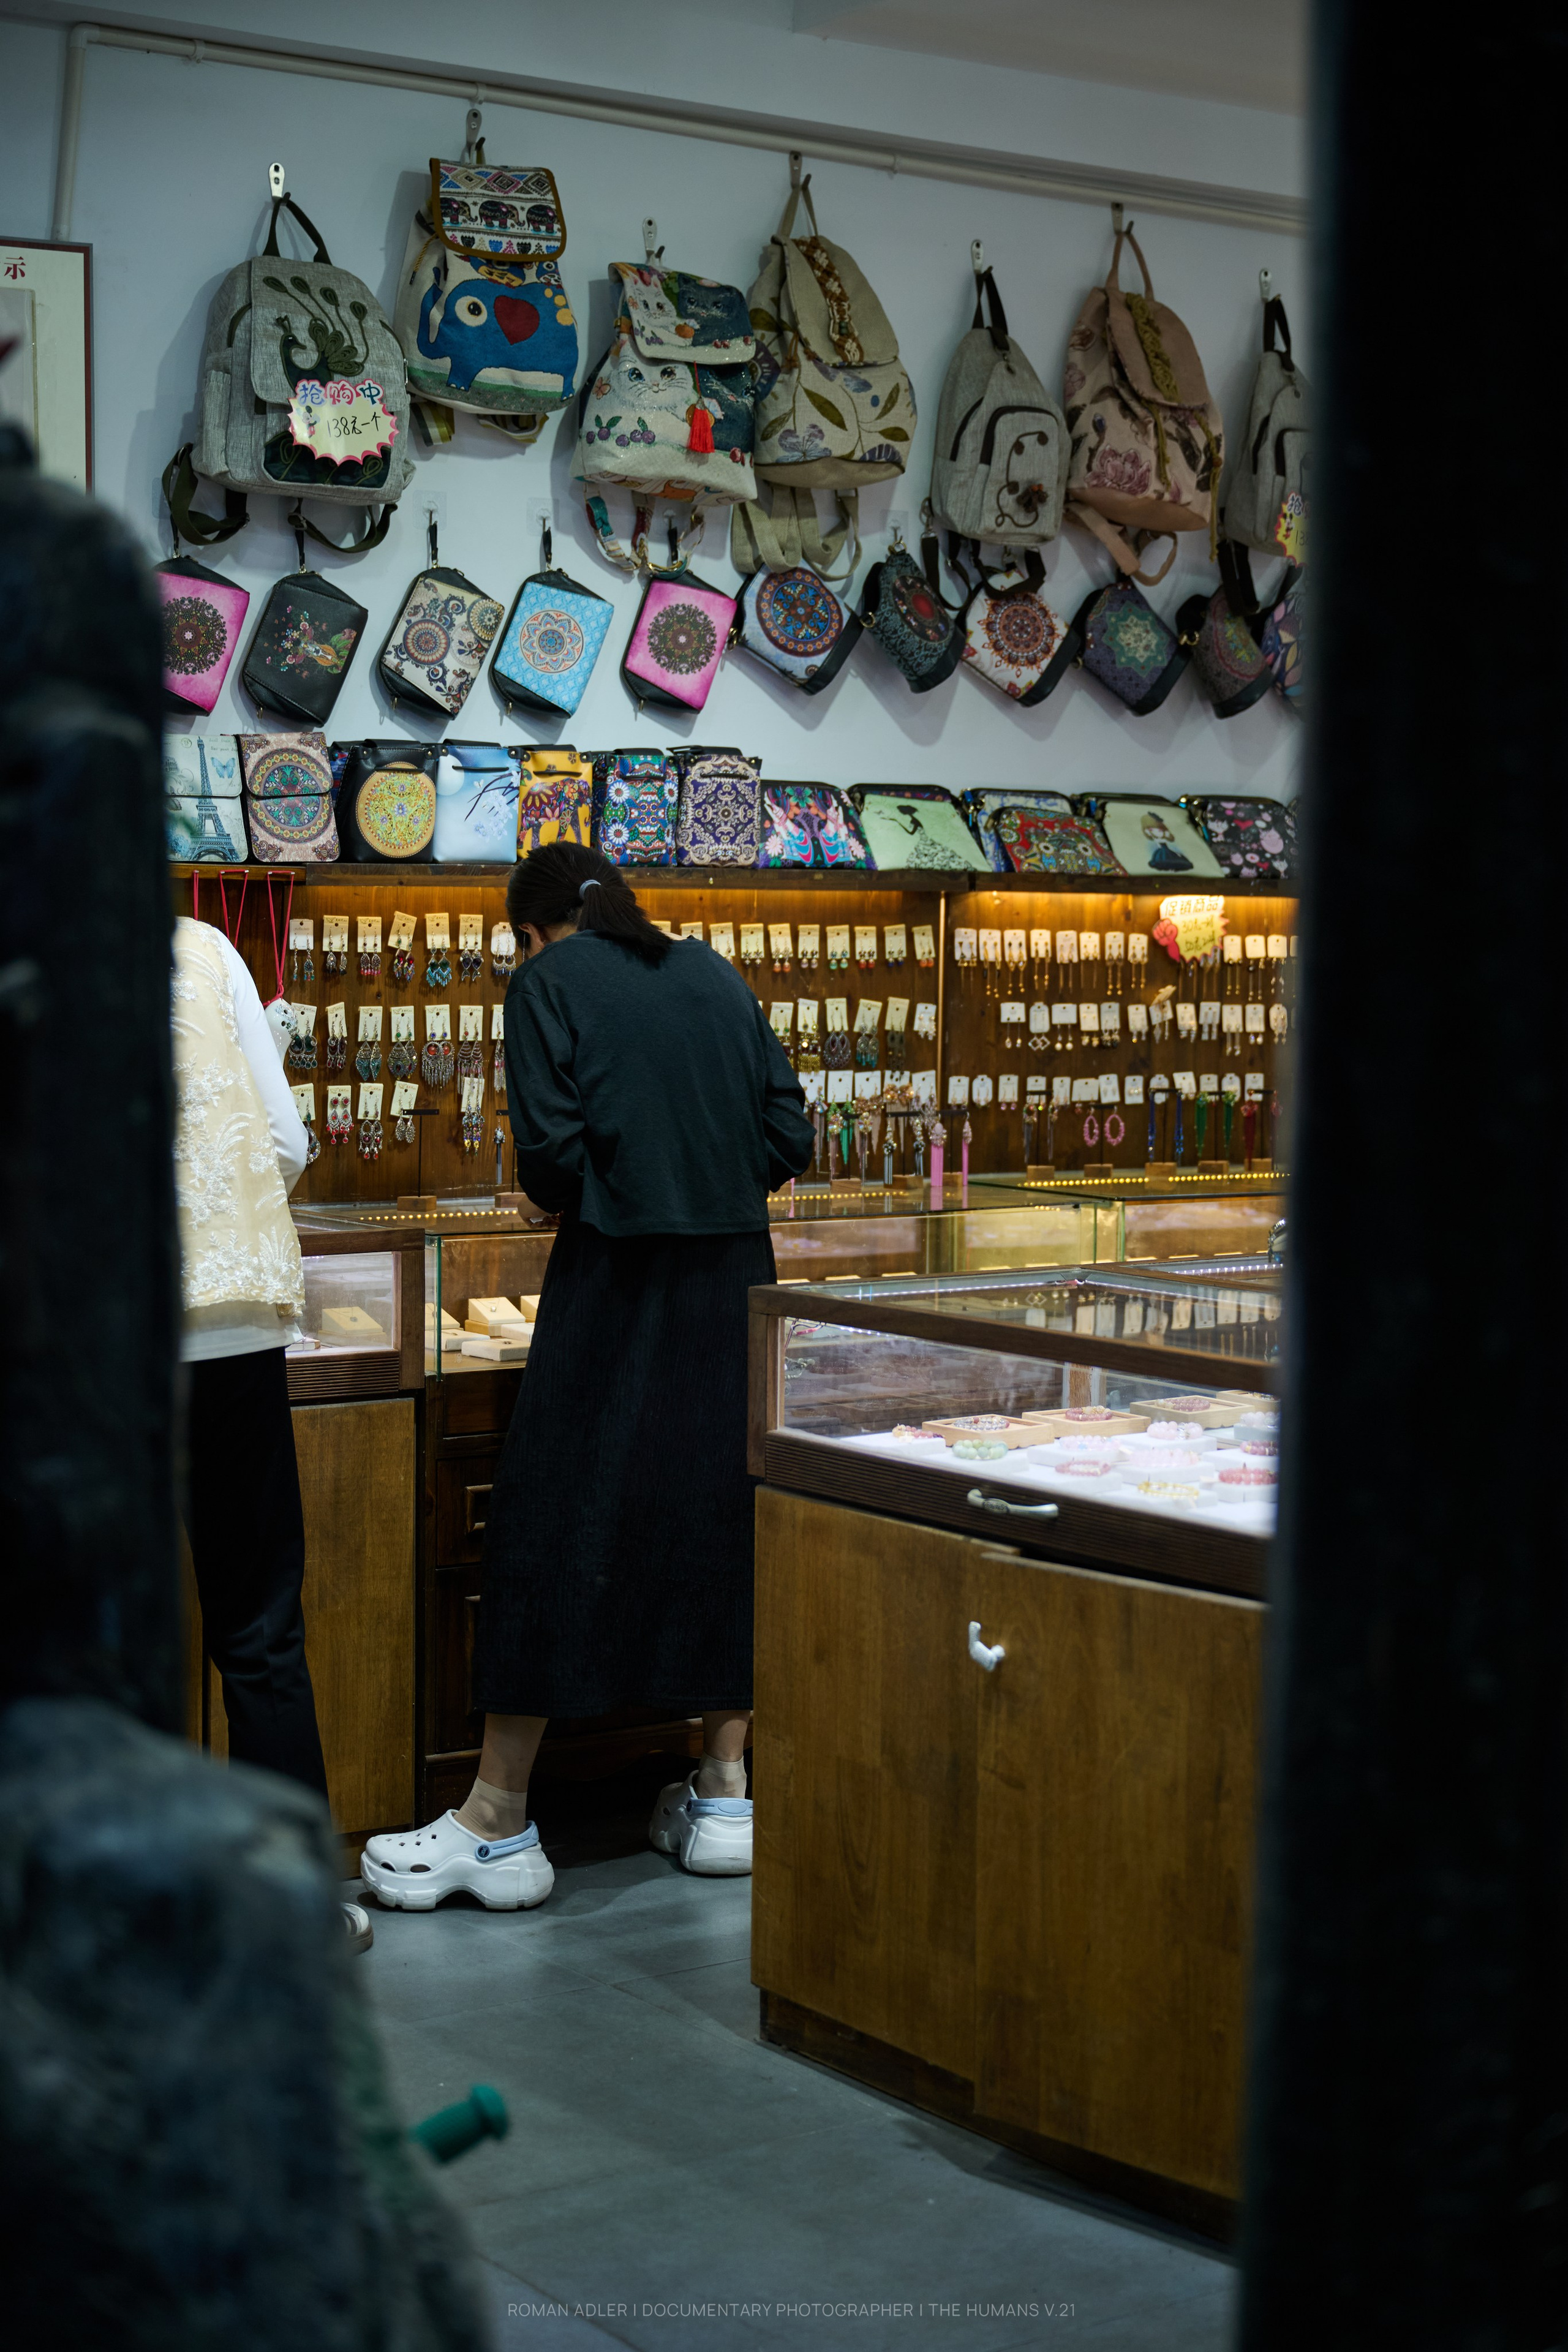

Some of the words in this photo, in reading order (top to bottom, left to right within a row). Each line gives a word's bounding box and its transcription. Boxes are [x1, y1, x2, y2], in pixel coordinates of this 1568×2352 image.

[4, 256, 26, 280] 示
[298, 382, 381, 405] 抢购中
